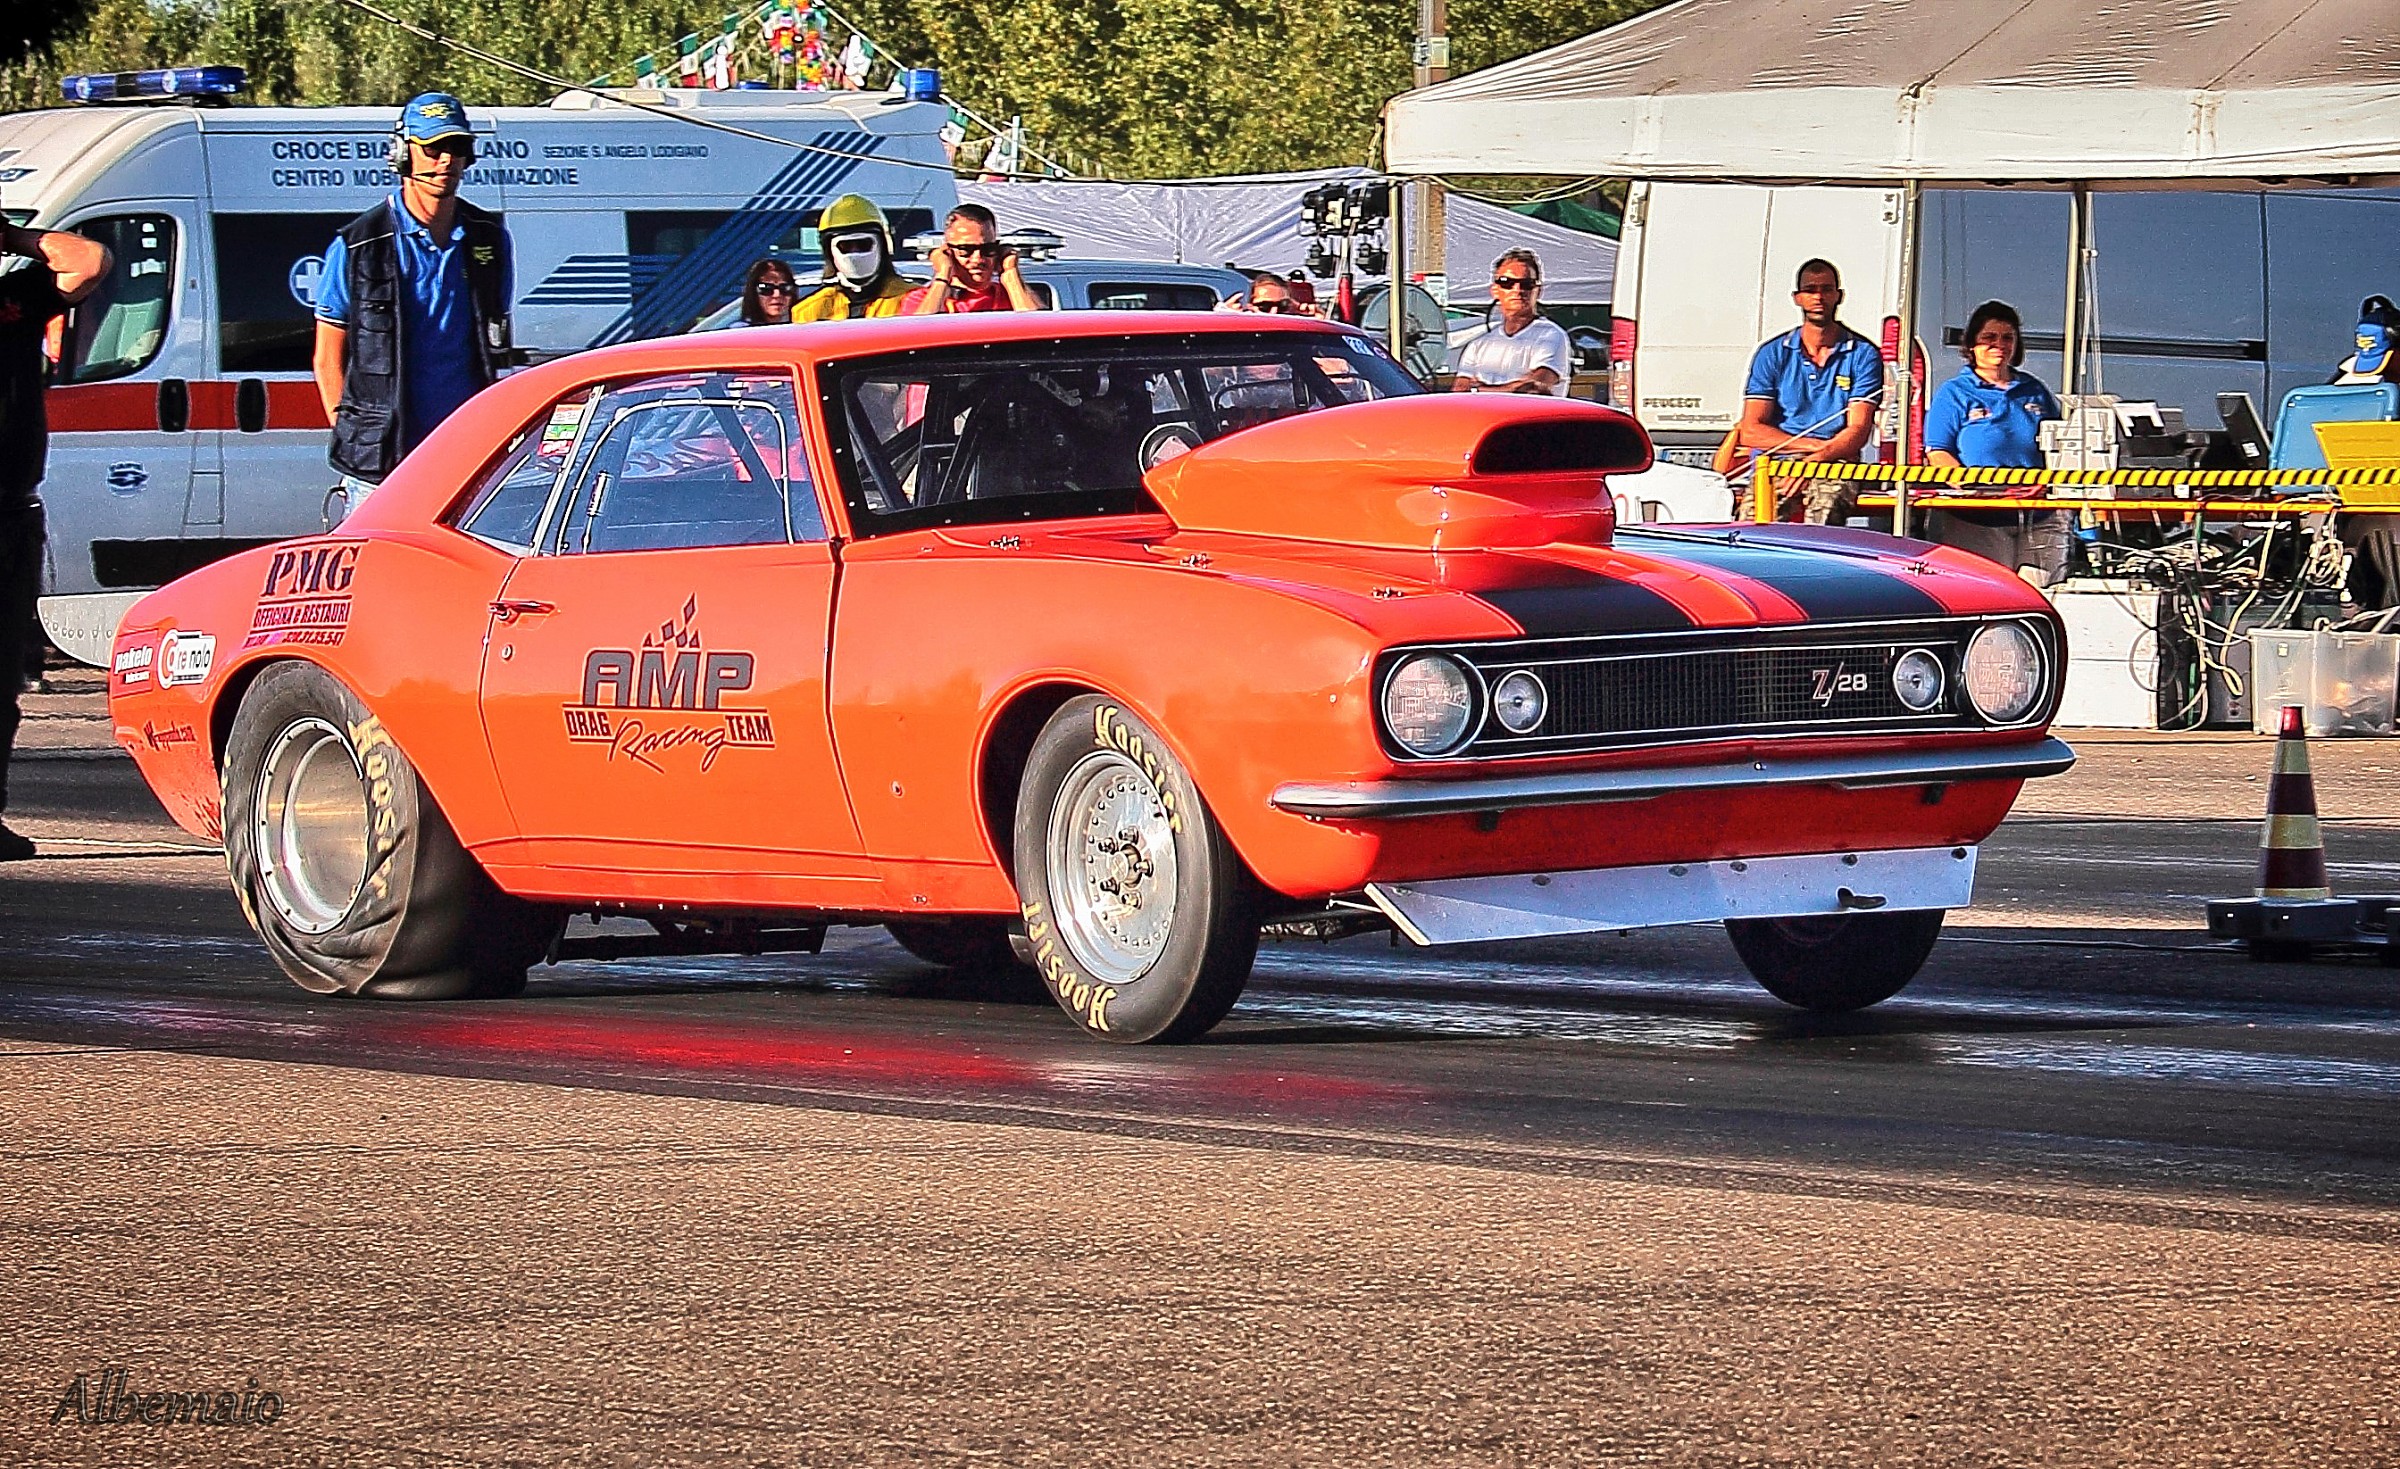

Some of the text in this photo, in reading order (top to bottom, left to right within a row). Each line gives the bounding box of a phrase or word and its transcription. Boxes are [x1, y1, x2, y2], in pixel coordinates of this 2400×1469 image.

[272, 141, 351, 159] CROCE
[356, 141, 390, 160] BIA
[543, 145, 589, 159] SEZIONE
[272, 169, 344, 187] CENTRO
[261, 546, 360, 597] PMG
[253, 606, 295, 628] OFFICINA
[300, 602, 351, 624] RESTAURI
[113, 645, 154, 674] pakelo
[188, 642, 211, 669] nolo
[583, 650, 754, 710] AMP
[565, 710, 774, 774] DRAG Racing TEAM
